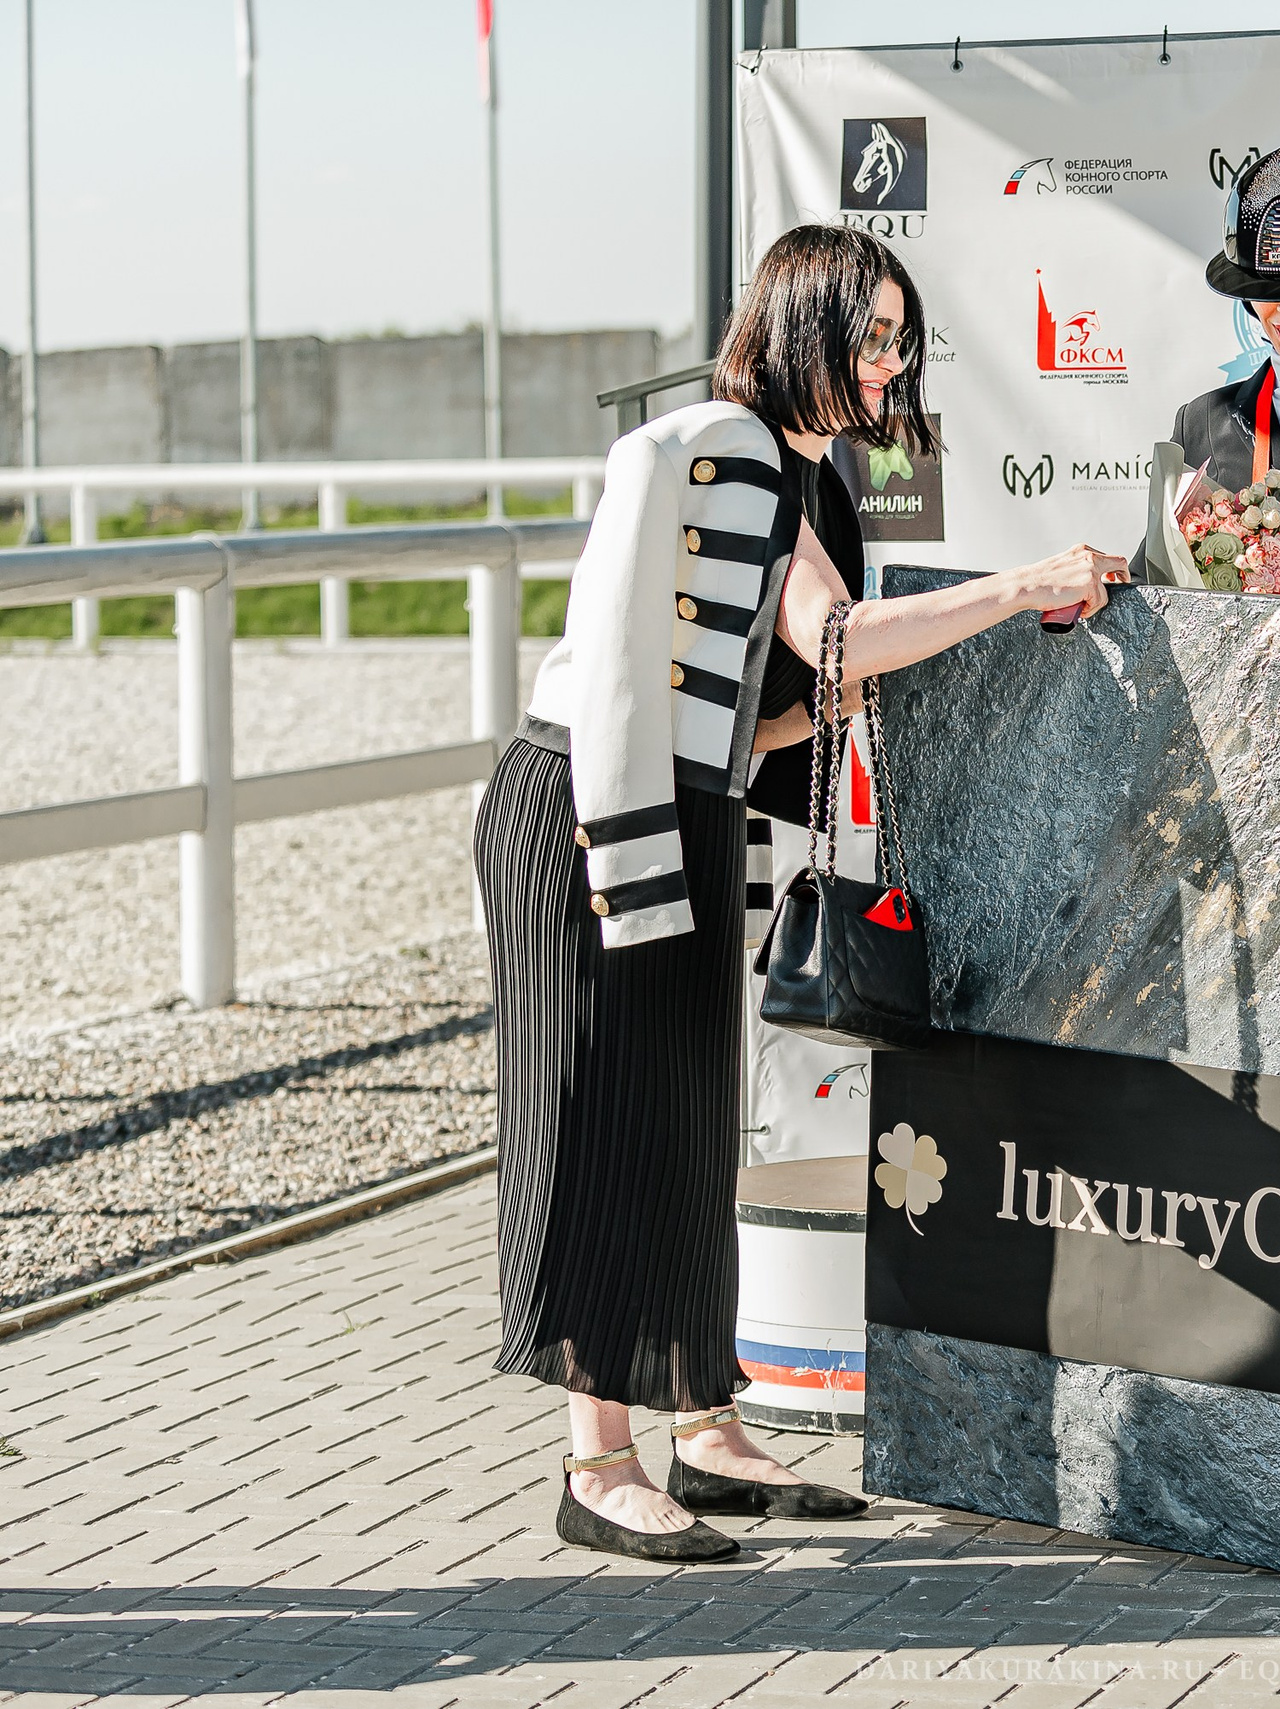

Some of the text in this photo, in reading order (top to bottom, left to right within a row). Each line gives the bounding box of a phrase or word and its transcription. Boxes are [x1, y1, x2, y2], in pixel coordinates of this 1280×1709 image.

[1064, 158, 1132, 170] ФЕДЕРАЦИЯ
[1065, 170, 1168, 182] КОННОГО СПОРТА
[1066, 184, 1113, 195] РОССИИ
[927, 351, 957, 362] duct
[1060, 348, 1123, 364] ФКСМ
[858, 494, 923, 513] АНИЛИН
